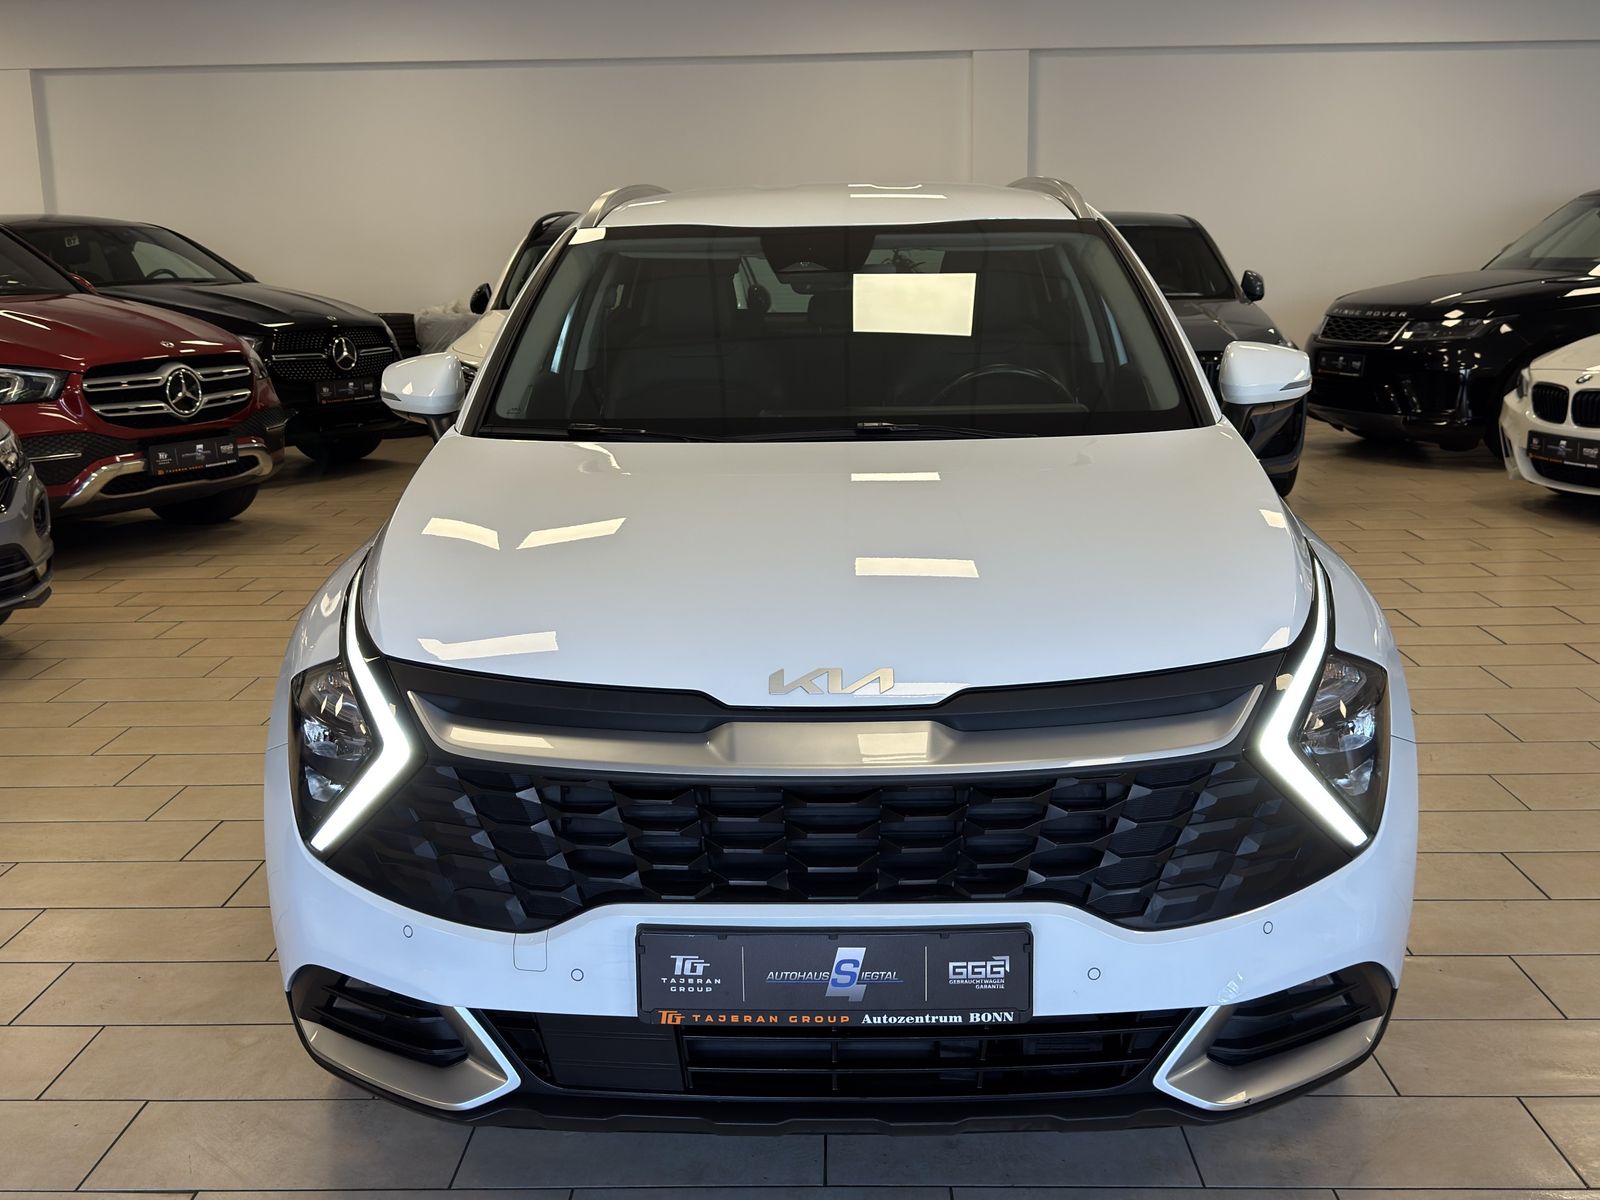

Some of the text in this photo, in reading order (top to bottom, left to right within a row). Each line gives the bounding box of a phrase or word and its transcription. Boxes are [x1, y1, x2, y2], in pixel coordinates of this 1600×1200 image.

[768, 667, 895, 695] KIA
[766, 971, 830, 981] AUTOHAUS
[948, 960, 1005, 979] GGG
[661, 977, 721, 985] TAJERAN
[692, 1014, 778, 1024] TAJERAN
[789, 1015, 850, 1024] GROUP
[861, 1013, 963, 1025] Autozentrum
[969, 1011, 1014, 1023] BONN
